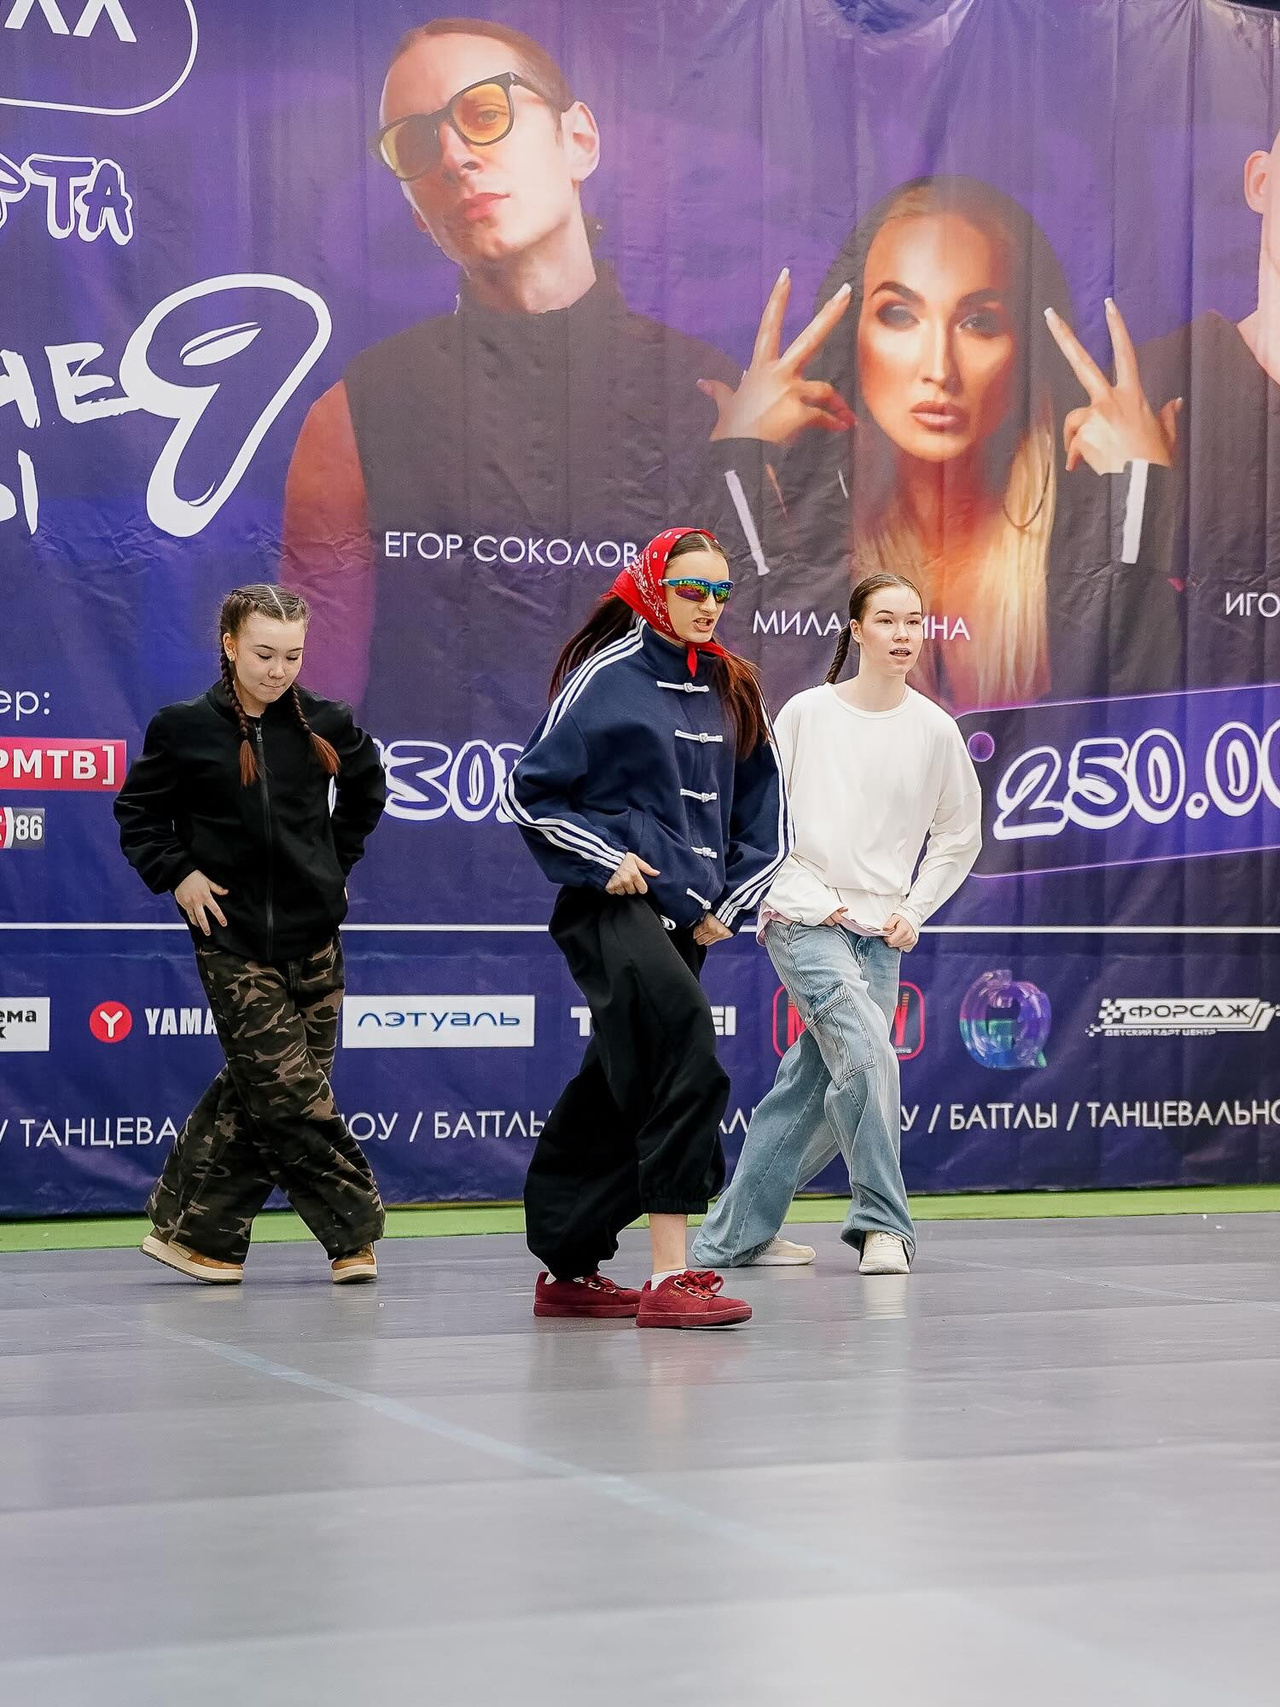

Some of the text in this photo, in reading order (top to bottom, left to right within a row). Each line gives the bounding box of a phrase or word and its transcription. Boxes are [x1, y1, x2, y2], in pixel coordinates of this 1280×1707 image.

[384, 530, 640, 568] ЕГОР СОКОЛОВ
[752, 609, 843, 637] МИЛА
[1128, 1004, 1250, 1018] ФОРСАЖ
[340, 1111, 399, 1141] ОУ
[950, 1102, 1058, 1131] БАТТЛЫ
